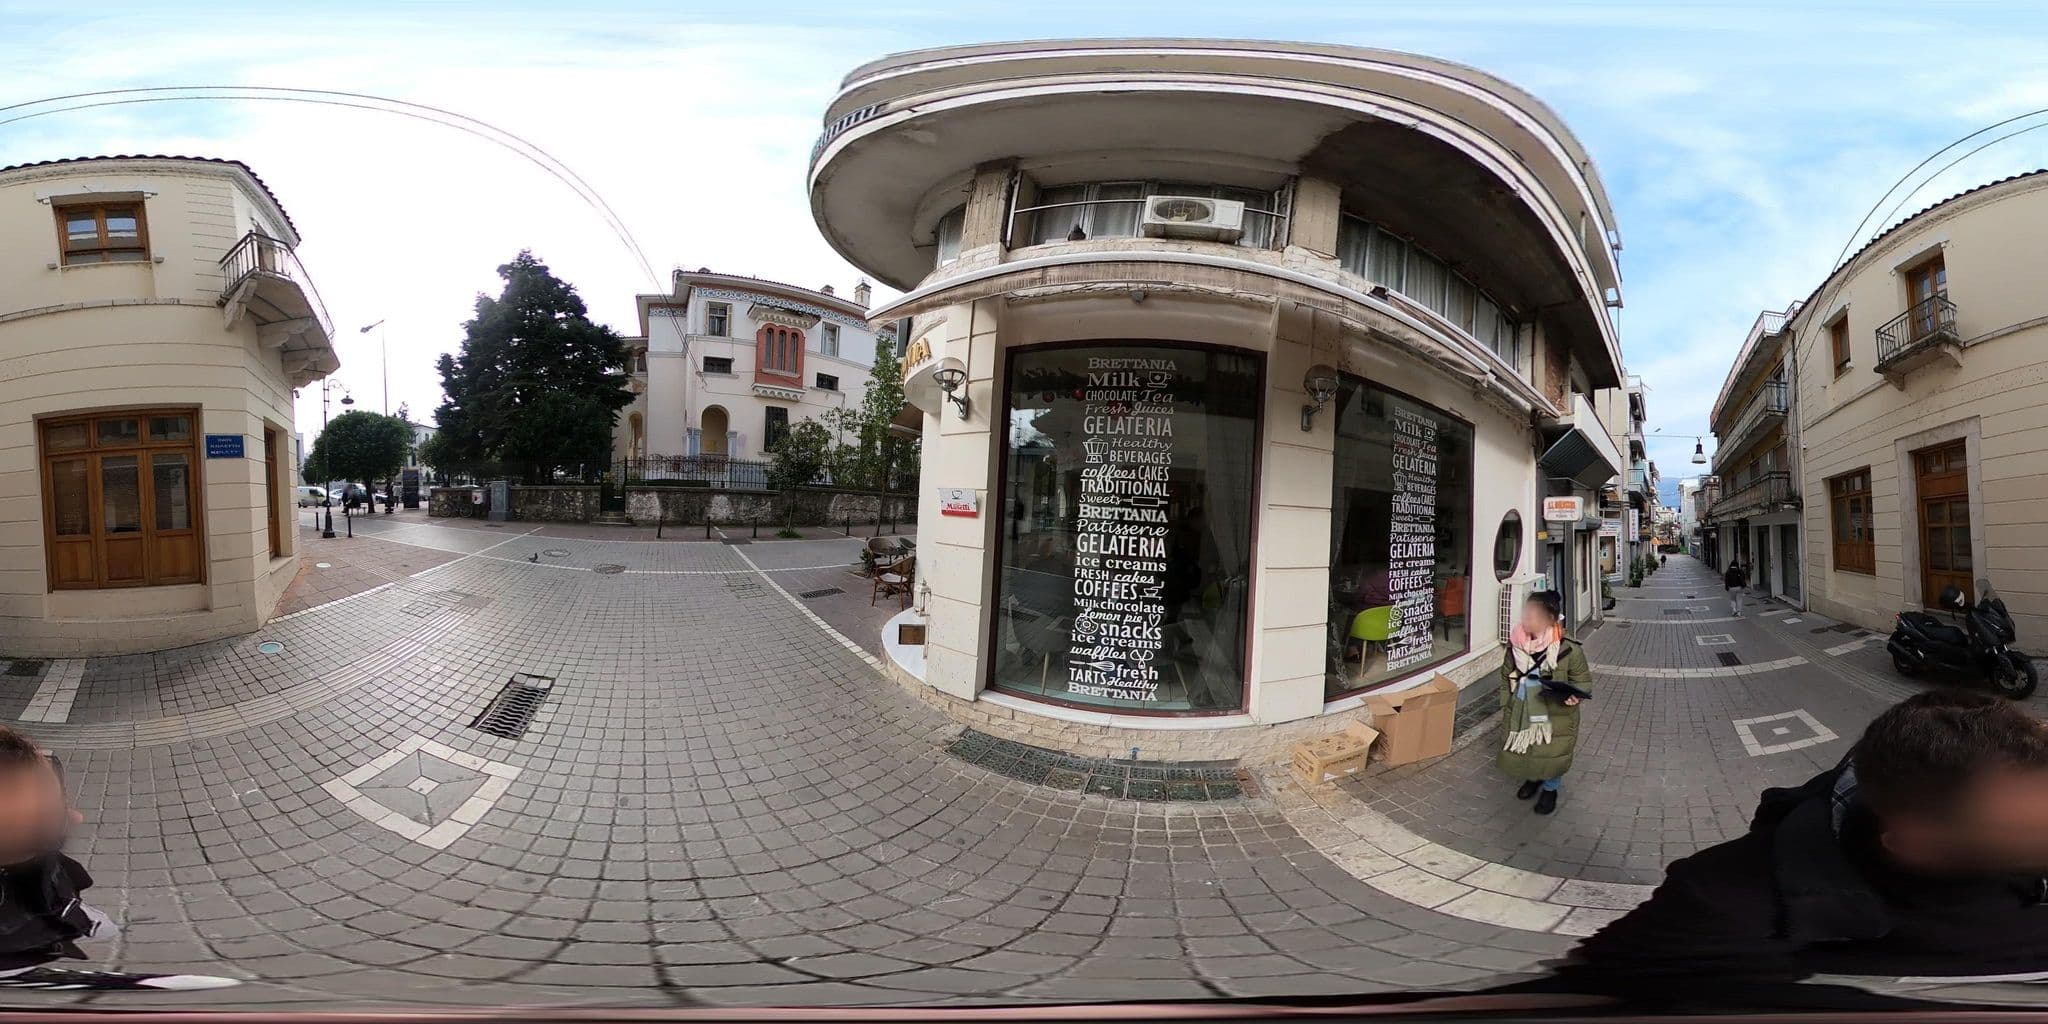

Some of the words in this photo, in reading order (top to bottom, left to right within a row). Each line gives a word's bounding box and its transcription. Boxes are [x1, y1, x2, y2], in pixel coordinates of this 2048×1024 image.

[1088, 358, 1176, 370] BRETTANIA
[1087, 372, 1141, 386] Milk
[1085, 390, 1137, 401] CHOCOLATE
[1140, 389, 1173, 402] Tea
[1085, 403, 1131, 415] Fresh
[1131, 402, 1174, 416] Juices
[1084, 416, 1172, 436] GELATERIA
[1395, 407, 1437, 430] BRETTANIA
[1395, 420, 1421, 437] Milk
[1112, 438, 1172, 450] Healthy
[1393, 444, 1416, 455] Fresh
[1421, 441, 1436, 453] Tea
[1110, 450, 1172, 464] BEVERAGES
[1393, 454, 1436, 476] GELATERIA
[1081, 464, 1135, 482] coffees
[1138, 466, 1169, 481] CAKES
[1408, 473, 1436, 485] Healthy
[1080, 479, 1169, 496] TRADITIONAL
[1407, 482, 1436, 494] BEVERAGES
[1079, 494, 1122, 505] Sweets
[1421, 495, 1435, 505] CAKES
[1078, 504, 1168, 522] BRETTANIA
[1392, 503, 1436, 515] TRADITIONAL
[1076, 519, 1169, 536] Patisserie
[1391, 522, 1435, 533] BRETTANIA
[1077, 533, 1166, 558] GELATERIA
[1390, 533, 1436, 543] Patisserie
[1390, 543, 1435, 558] GELATERIA
[1076, 553, 1099, 566] ice
[1106, 559, 1166, 572] creams
[1390, 559, 1404, 569] ice
[1406, 559, 1435, 567] creams
[1075, 568, 1109, 580] FRESH
[1113, 572, 1154, 583] cakes
[1389, 569, 1408, 578] FRESH
[1075, 579, 1137, 600] COFFEES
[1390, 576, 1422, 591] COFFEES
[1074, 598, 1100, 608] Milk
[1100, 599, 1164, 614] chocolate
[1404, 601, 1433, 618] snacks
[1080, 608, 1121, 621] Lemon
[1123, 612, 1143, 625] pie
[1389, 620, 1402, 629] ice
[1405, 613, 1433, 624] creams
[1100, 622, 1161, 639] snacks
[1072, 630, 1095, 643] ice
[1101, 637, 1162, 649] creams
[1412, 632, 1432, 645] fresh
[1070, 646, 1126, 660] waffles
[1388, 647, 1408, 660] TARTS
[1387, 651, 1432, 671] BRETTANIA
[1069, 668, 1106, 684] TARTS
[1107, 677, 1158, 690] Healthy
[1117, 665, 1158, 680] fresh
[1068, 682, 1158, 701] BRETTANIA
